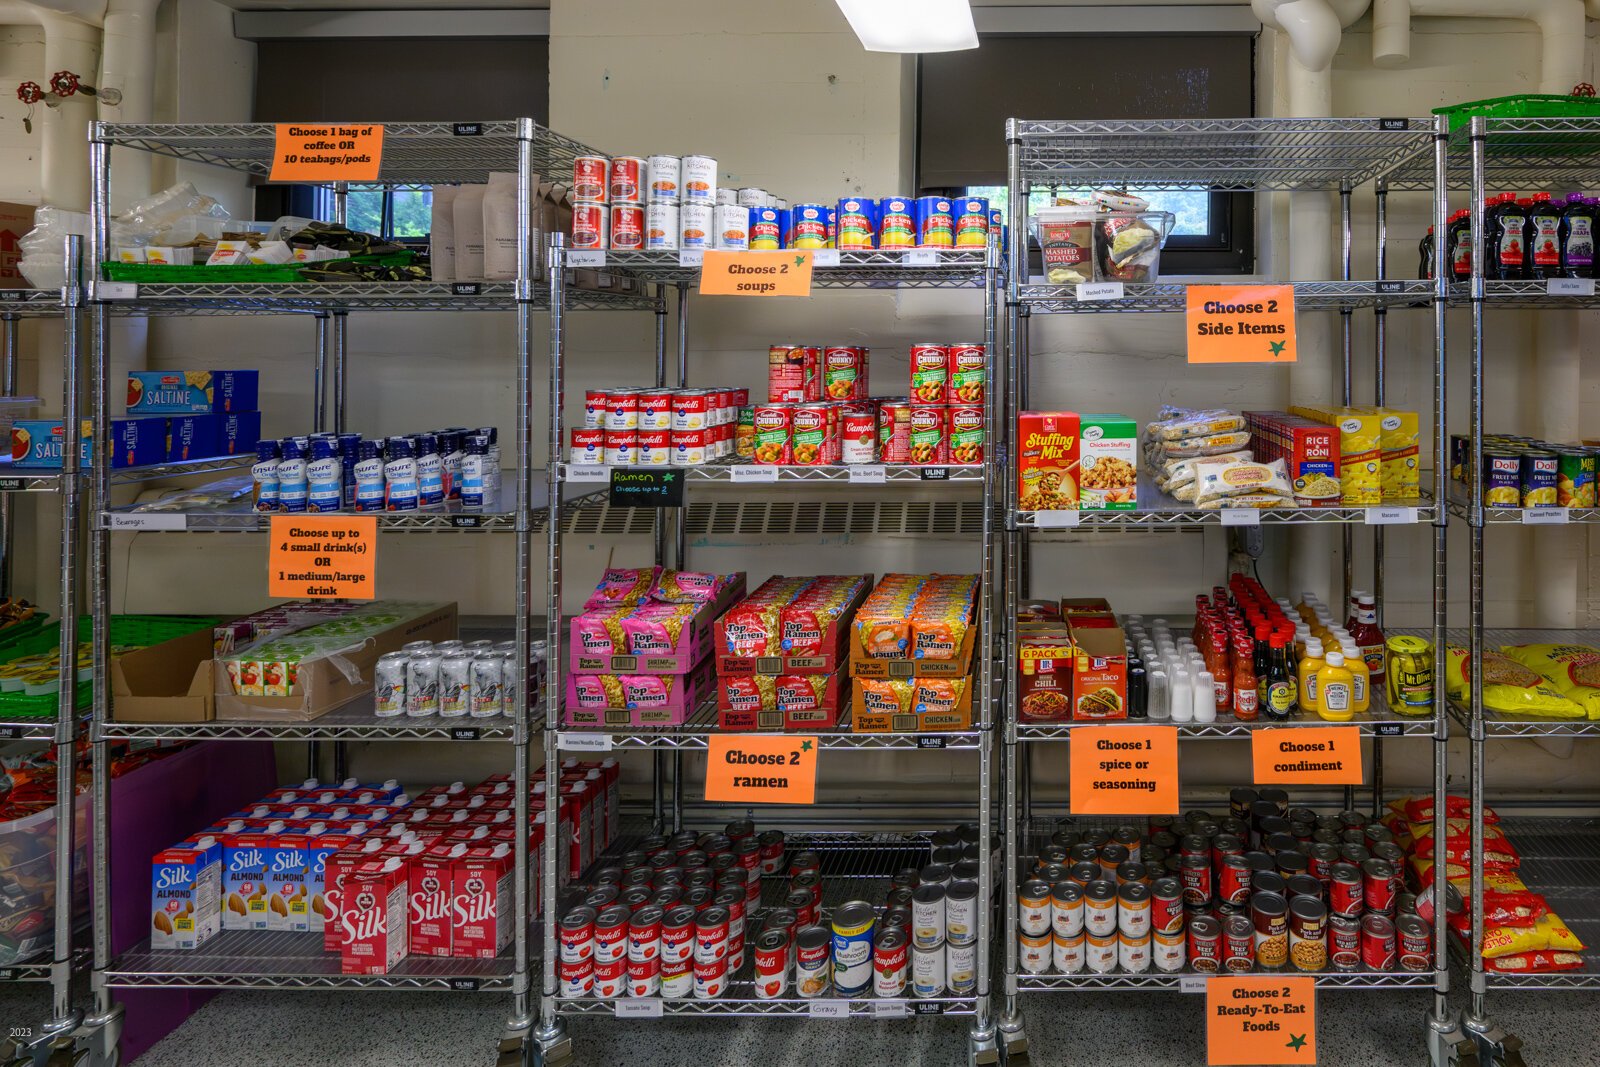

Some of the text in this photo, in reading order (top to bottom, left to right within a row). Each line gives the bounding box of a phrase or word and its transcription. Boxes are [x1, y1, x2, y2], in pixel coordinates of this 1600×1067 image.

[289, 126, 372, 138] Choose 1 bag of
[304, 140, 355, 150] coffee OR
[284, 154, 371, 166] 10 teabags/pods
[840, 217, 866, 225] Chicken
[884, 216, 910, 225] Chicken
[728, 264, 788, 275] Choose 2
[737, 282, 776, 293] soups
[1204, 300, 1278, 314] Choose 2
[1198, 322, 1286, 336] Side Items
[830, 356, 854, 364] CHUNKY
[918, 356, 944, 364] CHUNKY
[225, 372, 233, 398] SALTINE
[146, 390, 191, 405] SALTINE
[757, 416, 783, 424] CHUNKY
[794, 417, 818, 425] CHUNKY
[954, 416, 980, 424] CHUNKY
[126, 421, 136, 450] SALTINE
[184, 418, 193, 446] SALTINE
[1026, 432, 1074, 450] Stuffing
[1306, 436, 1329, 445] RICE
[1040, 446, 1064, 460] Mix
[1306, 449, 1330, 457] RONI
[1494, 460, 1518, 470] Dolly
[614, 472, 654, 482] Ramen
[925, 468, 946, 476] ULINE
[662, 486, 668, 495] 2
[116, 517, 144, 527] Beverages
[289, 528, 360, 540] Choose up to
[280, 542, 366, 554] 4 small drink(s)
[314, 558, 331, 567] OR
[279, 571, 366, 584] 1 medium/large
[306, 586, 338, 596] drink
[785, 622, 802, 630] Top
[632, 633, 652, 642] Top
[784, 630, 818, 638] Ramen
[916, 632, 936, 641] Top
[632, 640, 670, 650] Ramen
[916, 640, 952, 650] Ramen
[1024, 650, 1057, 658] 6 PACK
[791, 658, 812, 666] BEEF
[1406, 673, 1430, 684] Mt. Olive
[1034, 680, 1056, 688] CHILI
[628, 687, 648, 695] Top
[777, 687, 796, 696] Top
[919, 687, 938, 697] Top
[628, 693, 665, 702] Ramen
[778, 696, 814, 704] Ramen
[732, 702, 752, 710] BEEF
[793, 712, 814, 720] BEEF
[1096, 740, 1152, 750] Choose 1
[1279, 741, 1334, 752] Choose 1
[726, 750, 800, 766] Choose 2
[1100, 759, 1149, 772] spice or
[1274, 760, 1342, 772] condiment
[734, 776, 788, 788] ramen
[1092, 778, 1156, 792] seasoning
[230, 849, 264, 872] Silk
[272, 850, 306, 872] Silk
[156, 866, 192, 888] Silk
[230, 873, 264, 881] ALMOND
[272, 874, 304, 882] ALMOND
[156, 890, 191, 899] ALMOND
[411, 891, 450, 924] Silk
[453, 891, 496, 928] Silk
[342, 906, 386, 945] Silk
[800, 948, 826, 960] Campbell's
[836, 950, 867, 959] Mushroom
[874, 950, 905, 967] Campbell's
[562, 962, 592, 977] Campbell's
[1232, 987, 1291, 999] Choose 2
[812, 1004, 838, 1015] Gravy
[1217, 1004, 1306, 1018] Ready-To-Eat
[1242, 1020, 1280, 1032] Foods
